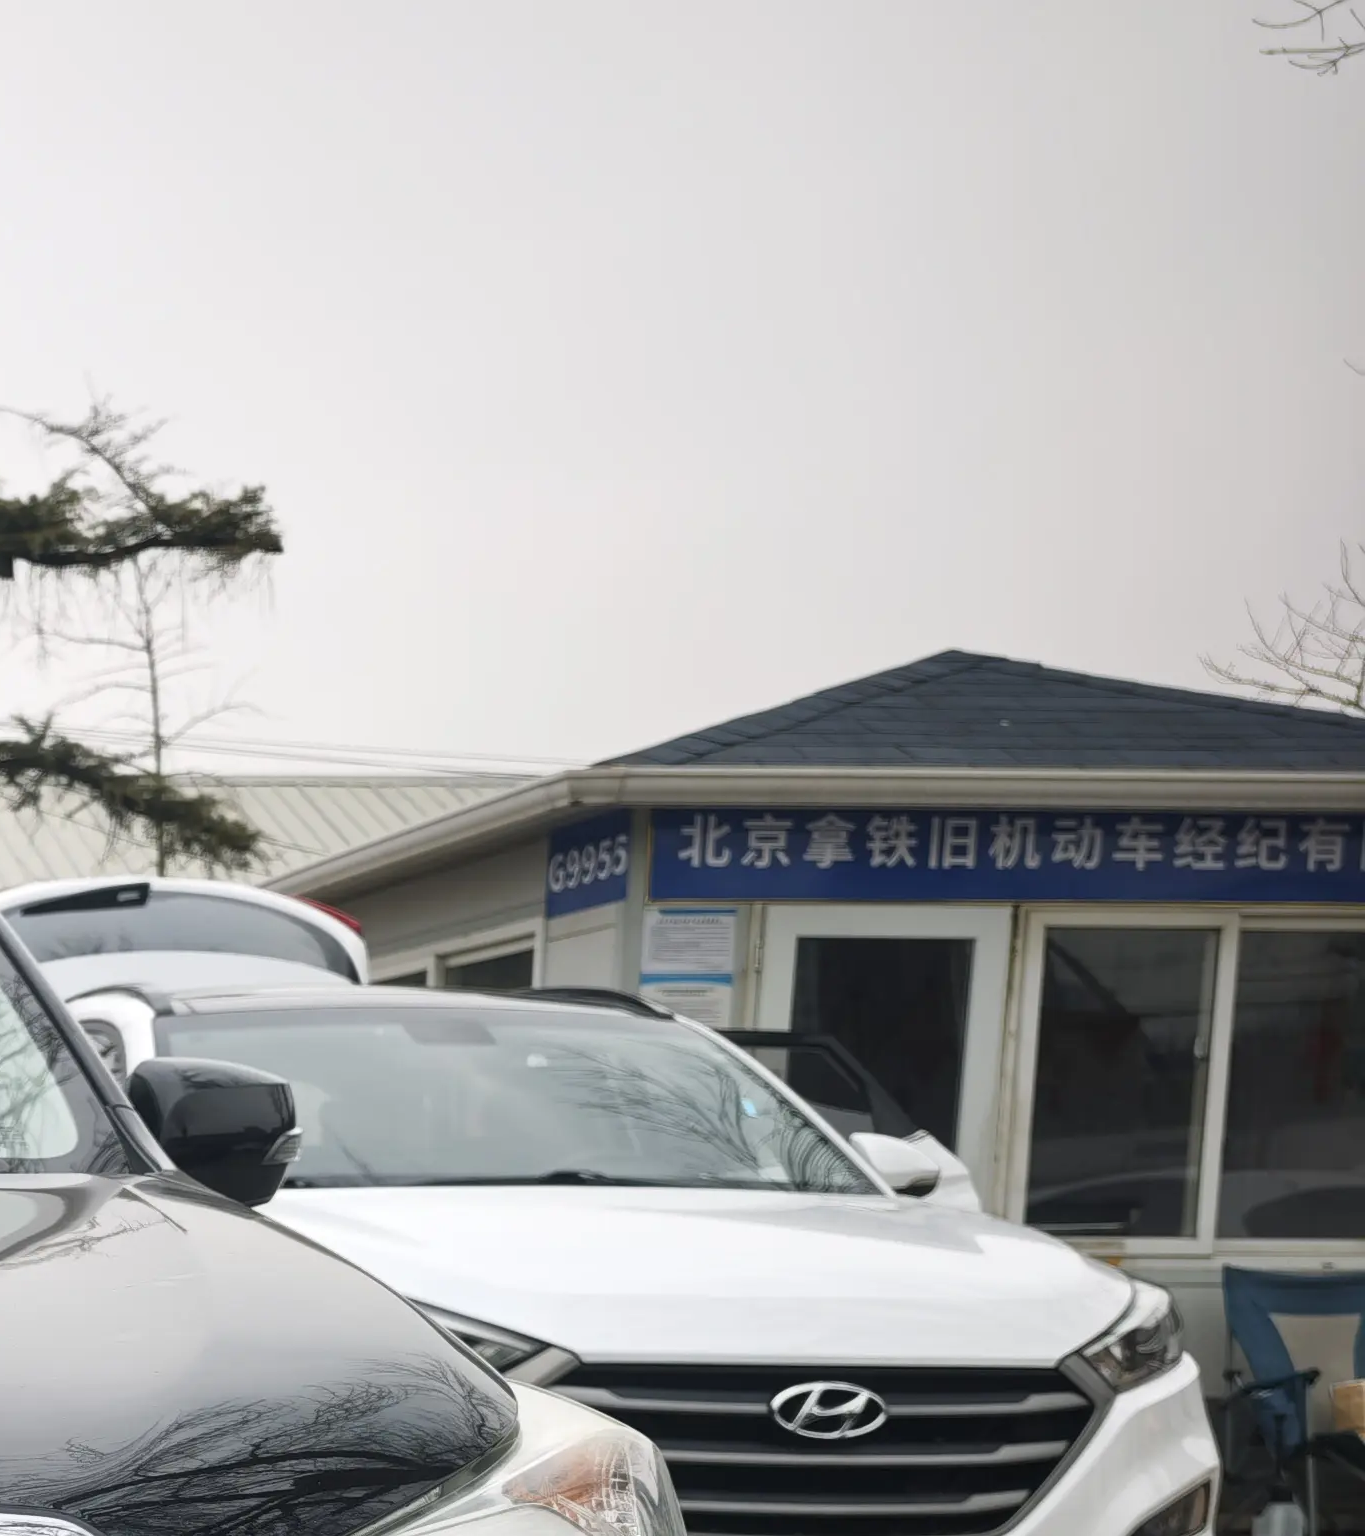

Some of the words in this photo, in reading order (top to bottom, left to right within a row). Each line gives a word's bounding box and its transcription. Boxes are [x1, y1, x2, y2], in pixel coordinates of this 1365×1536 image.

[677, 812, 1365, 872] 北京拿铁旧机动车经纪有
